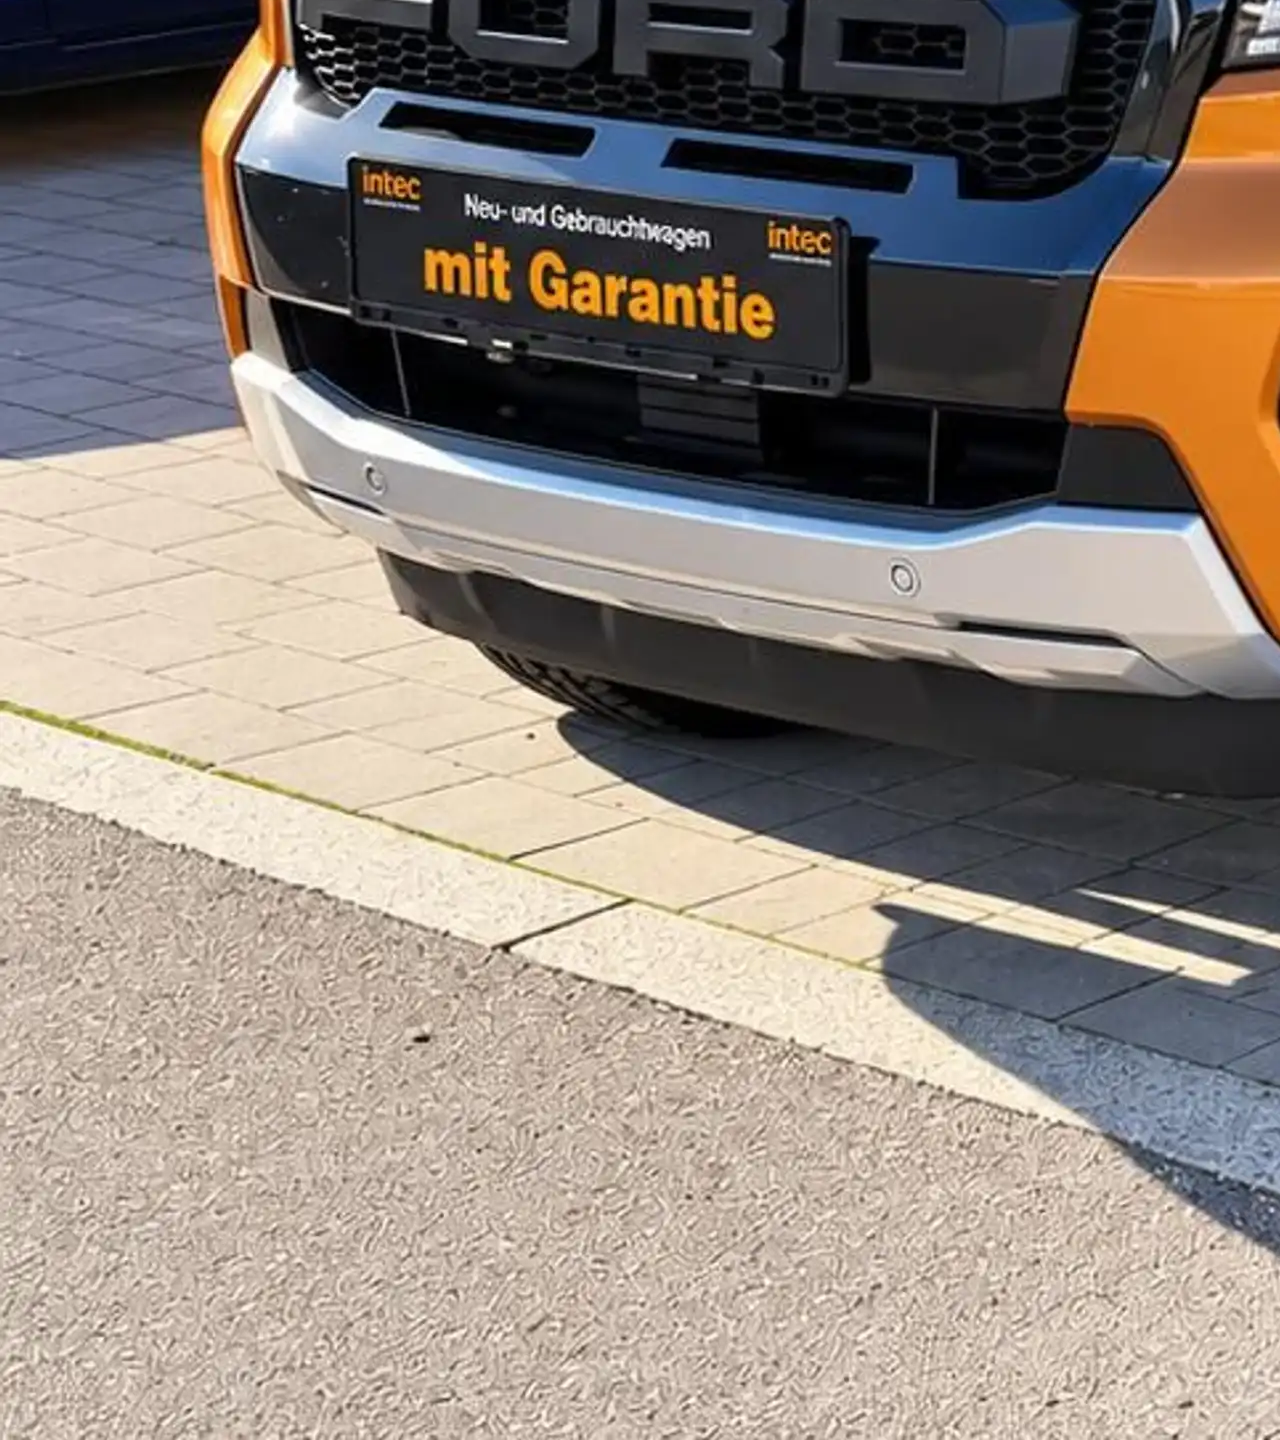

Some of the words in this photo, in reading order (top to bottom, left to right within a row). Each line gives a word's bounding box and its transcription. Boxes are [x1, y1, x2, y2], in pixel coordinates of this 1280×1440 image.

[361, 166, 422, 200] intec
[463, 192, 508, 222] Neu-
[511, 203, 545, 228] und
[550, 205, 712, 253] Gebrauchtwagen
[766, 220, 833, 255] intec
[423, 240, 512, 303] mit
[528, 249, 776, 341] Garantie
